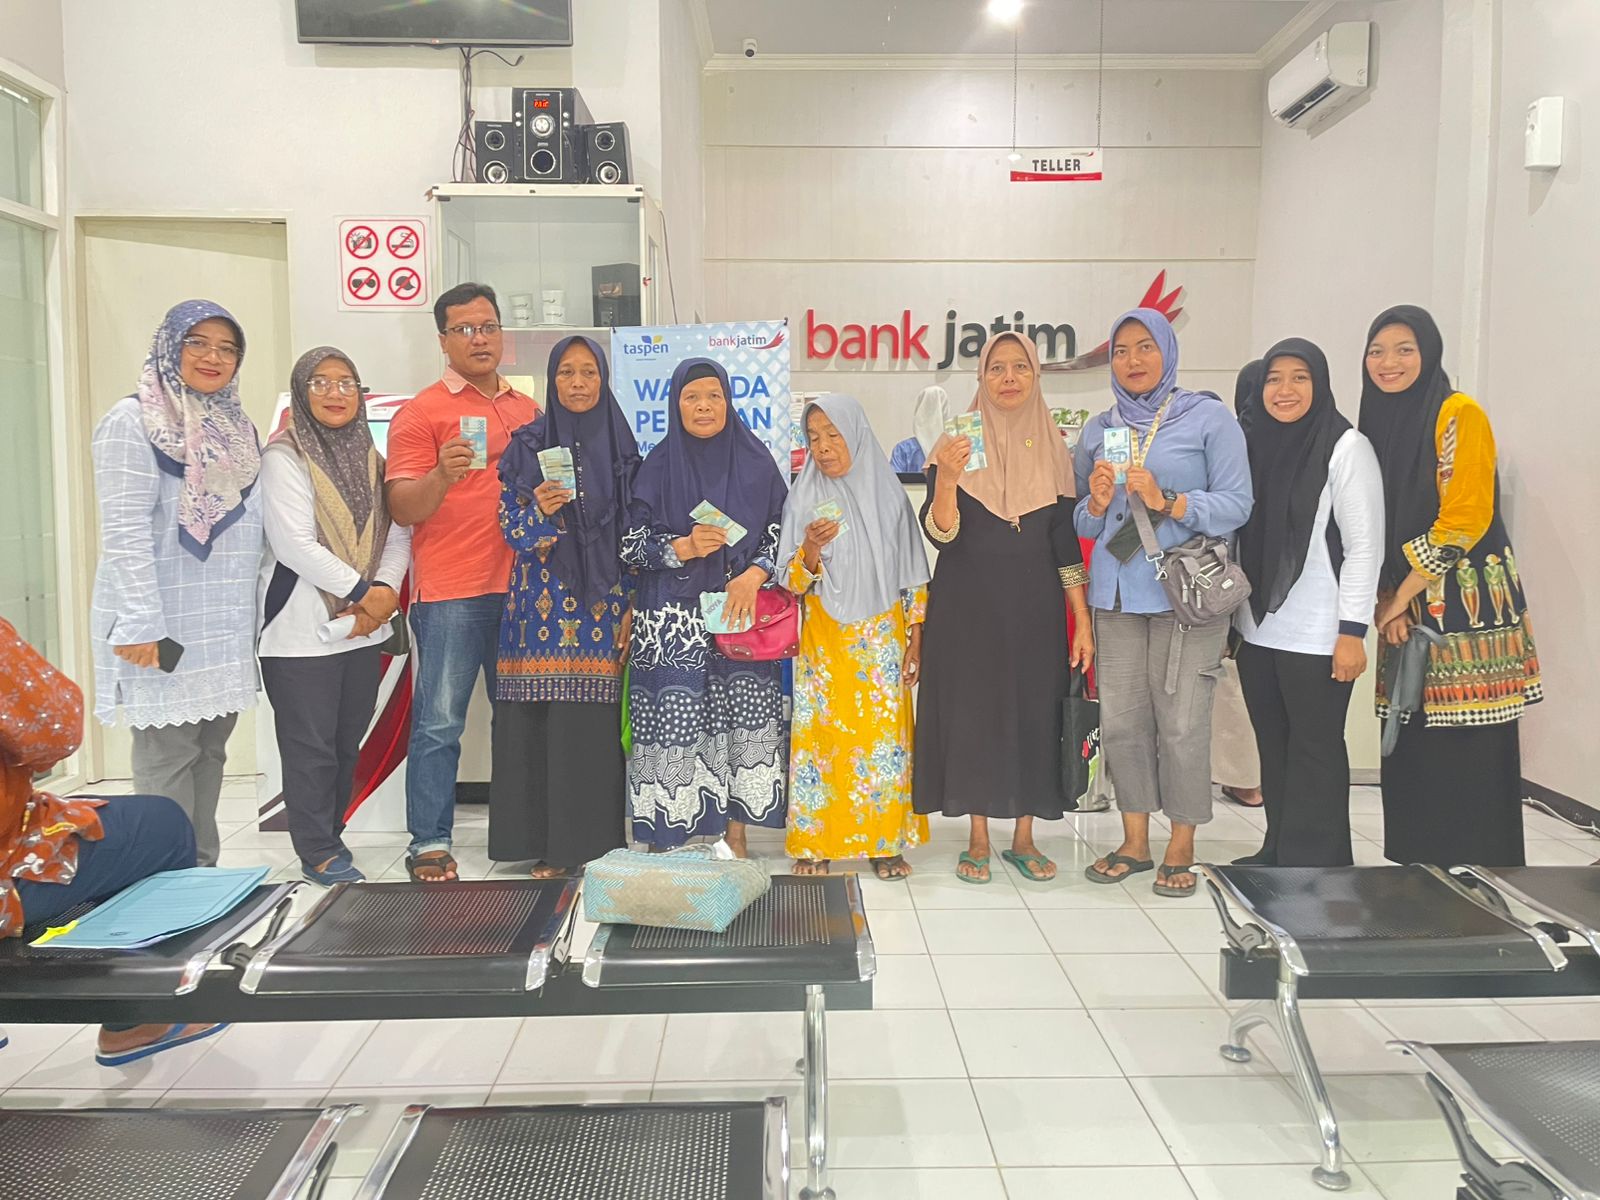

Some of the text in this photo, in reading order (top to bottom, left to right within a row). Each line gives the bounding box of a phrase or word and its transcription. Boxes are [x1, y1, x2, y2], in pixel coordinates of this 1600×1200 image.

[1032, 159, 1081, 171] TELLER
[806, 309, 1076, 370] bank jatim
[623, 343, 669, 356] taspen
